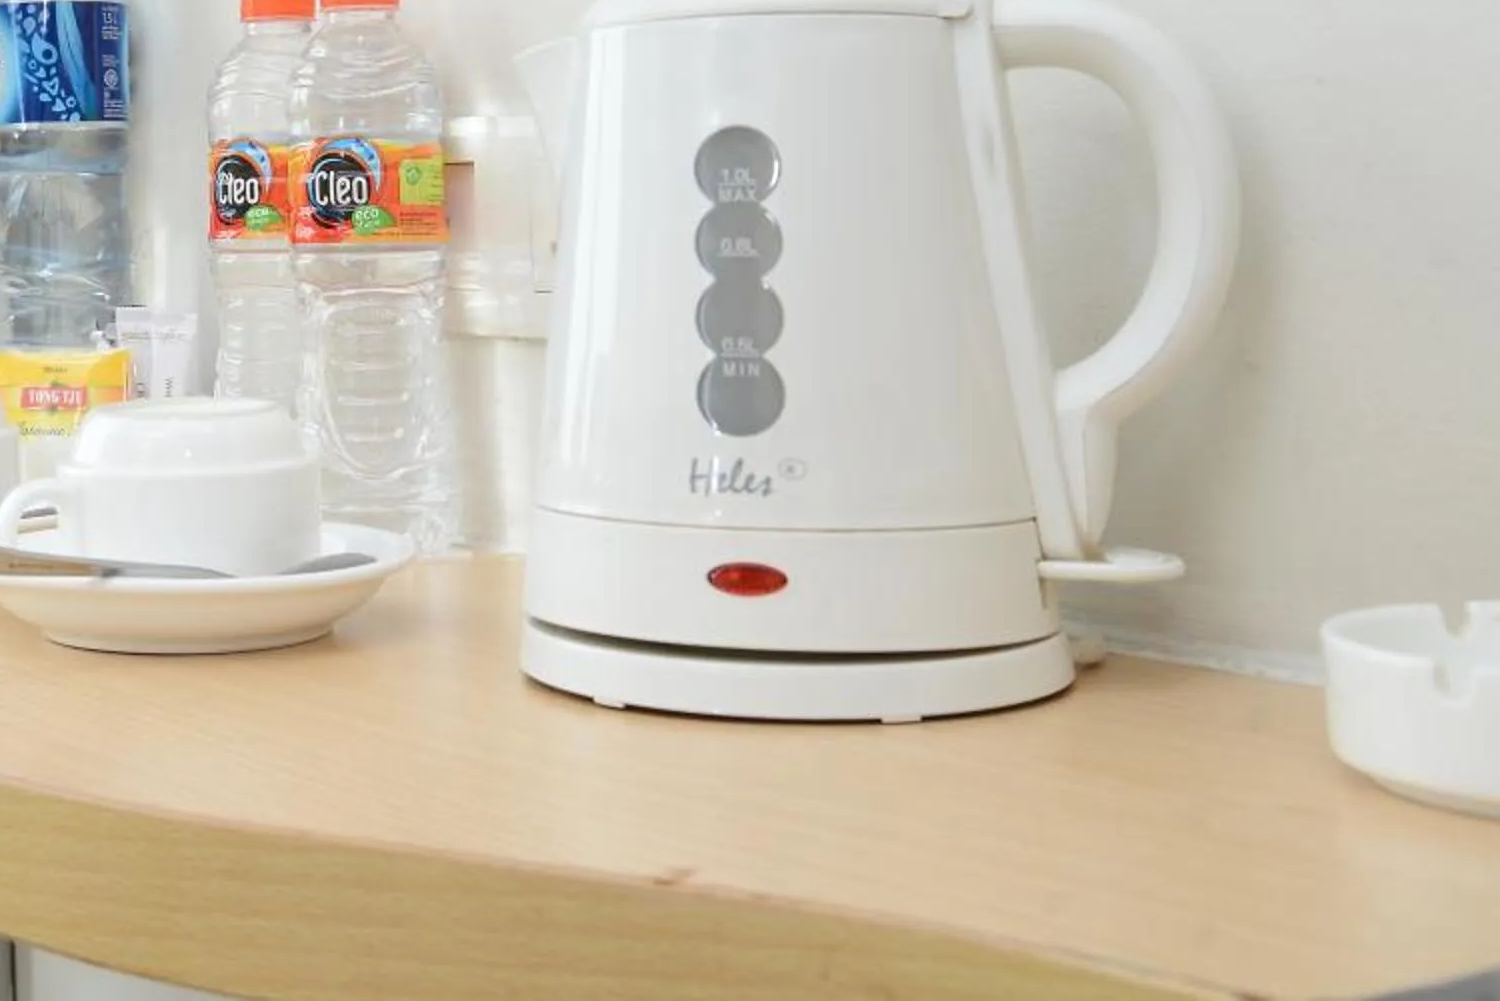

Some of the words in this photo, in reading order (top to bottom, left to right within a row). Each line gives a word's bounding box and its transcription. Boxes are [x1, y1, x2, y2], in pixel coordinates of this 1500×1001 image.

[219, 171, 259, 204] Cleo
[315, 170, 368, 206] Cleo
[355, 208, 379, 220] eco
[723, 362, 760, 376] MIN
[28, 389, 59, 404] TONG
